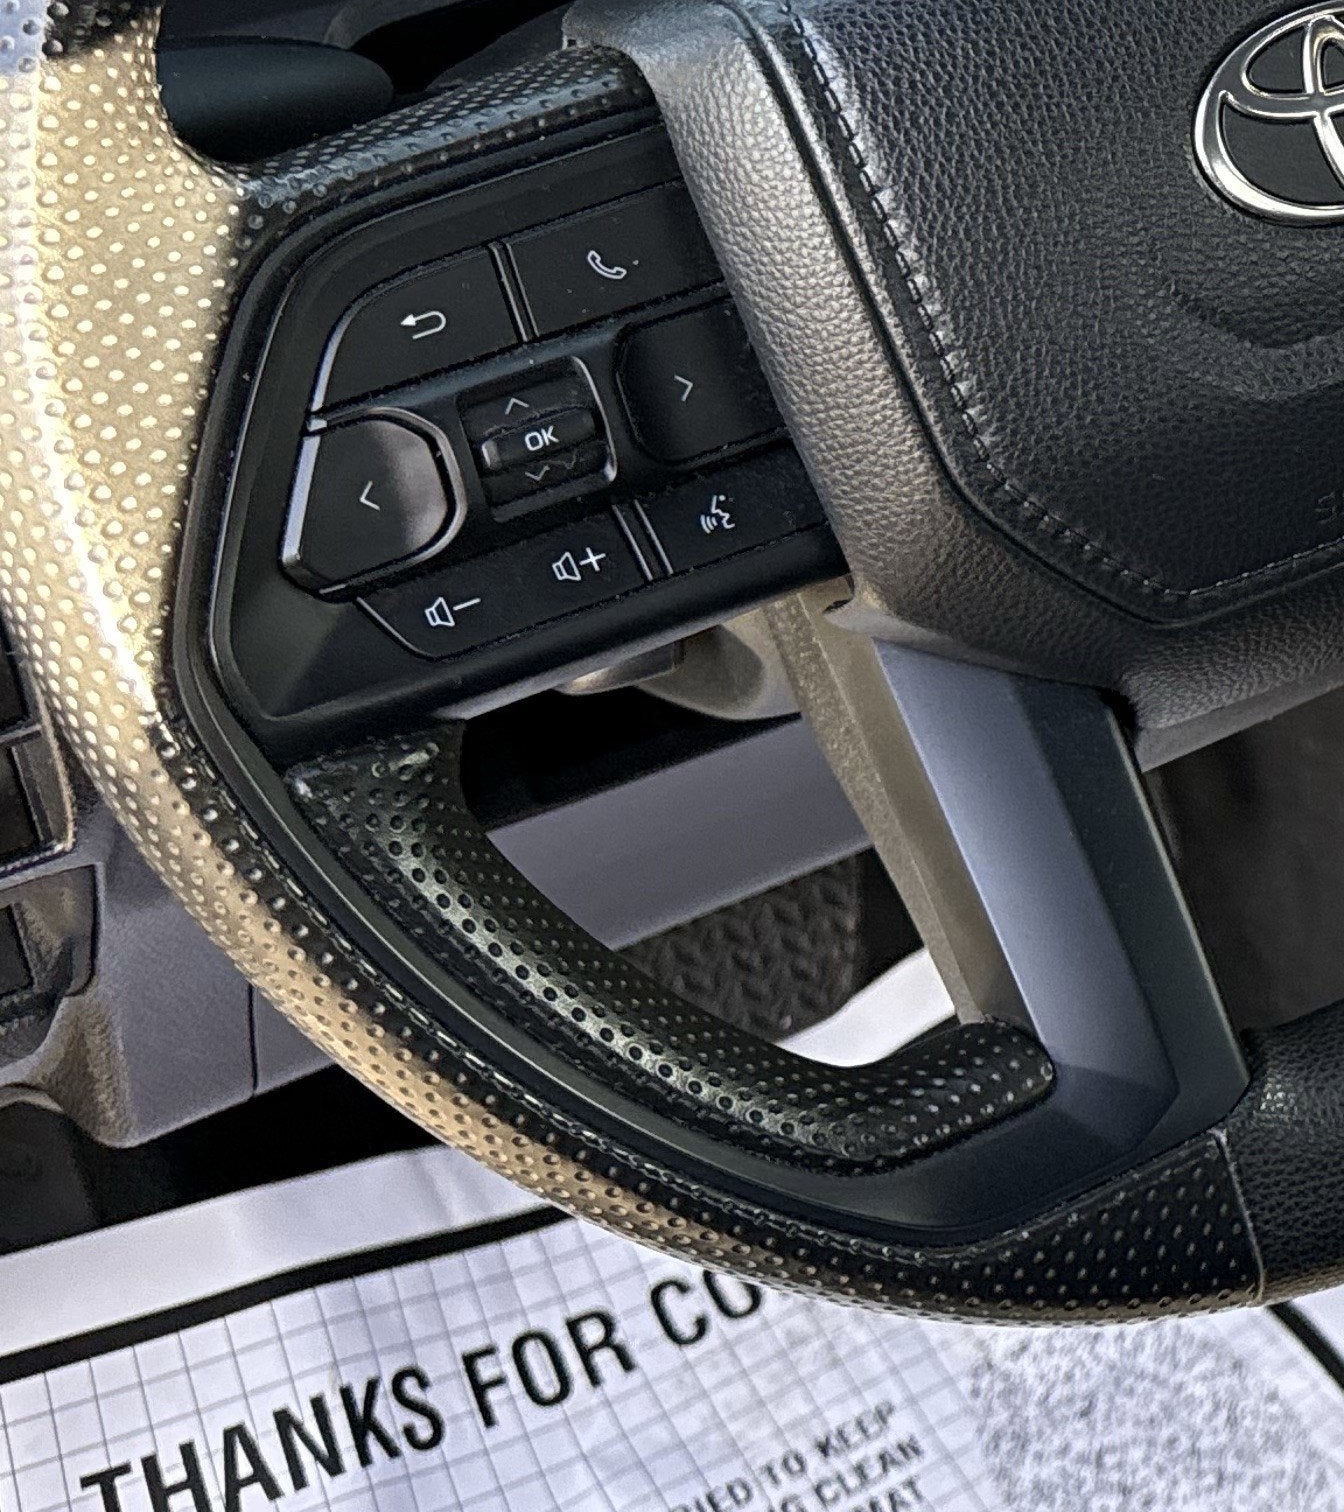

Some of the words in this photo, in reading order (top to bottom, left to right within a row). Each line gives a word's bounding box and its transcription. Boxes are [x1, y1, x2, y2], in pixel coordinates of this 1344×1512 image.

[524, 425, 559, 452] OK
[79, 1367, 445, 1512] THANKS
[462, 1306, 637, 1429] FOR
[761, 1447, 808, 1487] TO
[814, 1399, 896, 1460] KEEP
[814, 1434, 925, 1509] CLEAN
